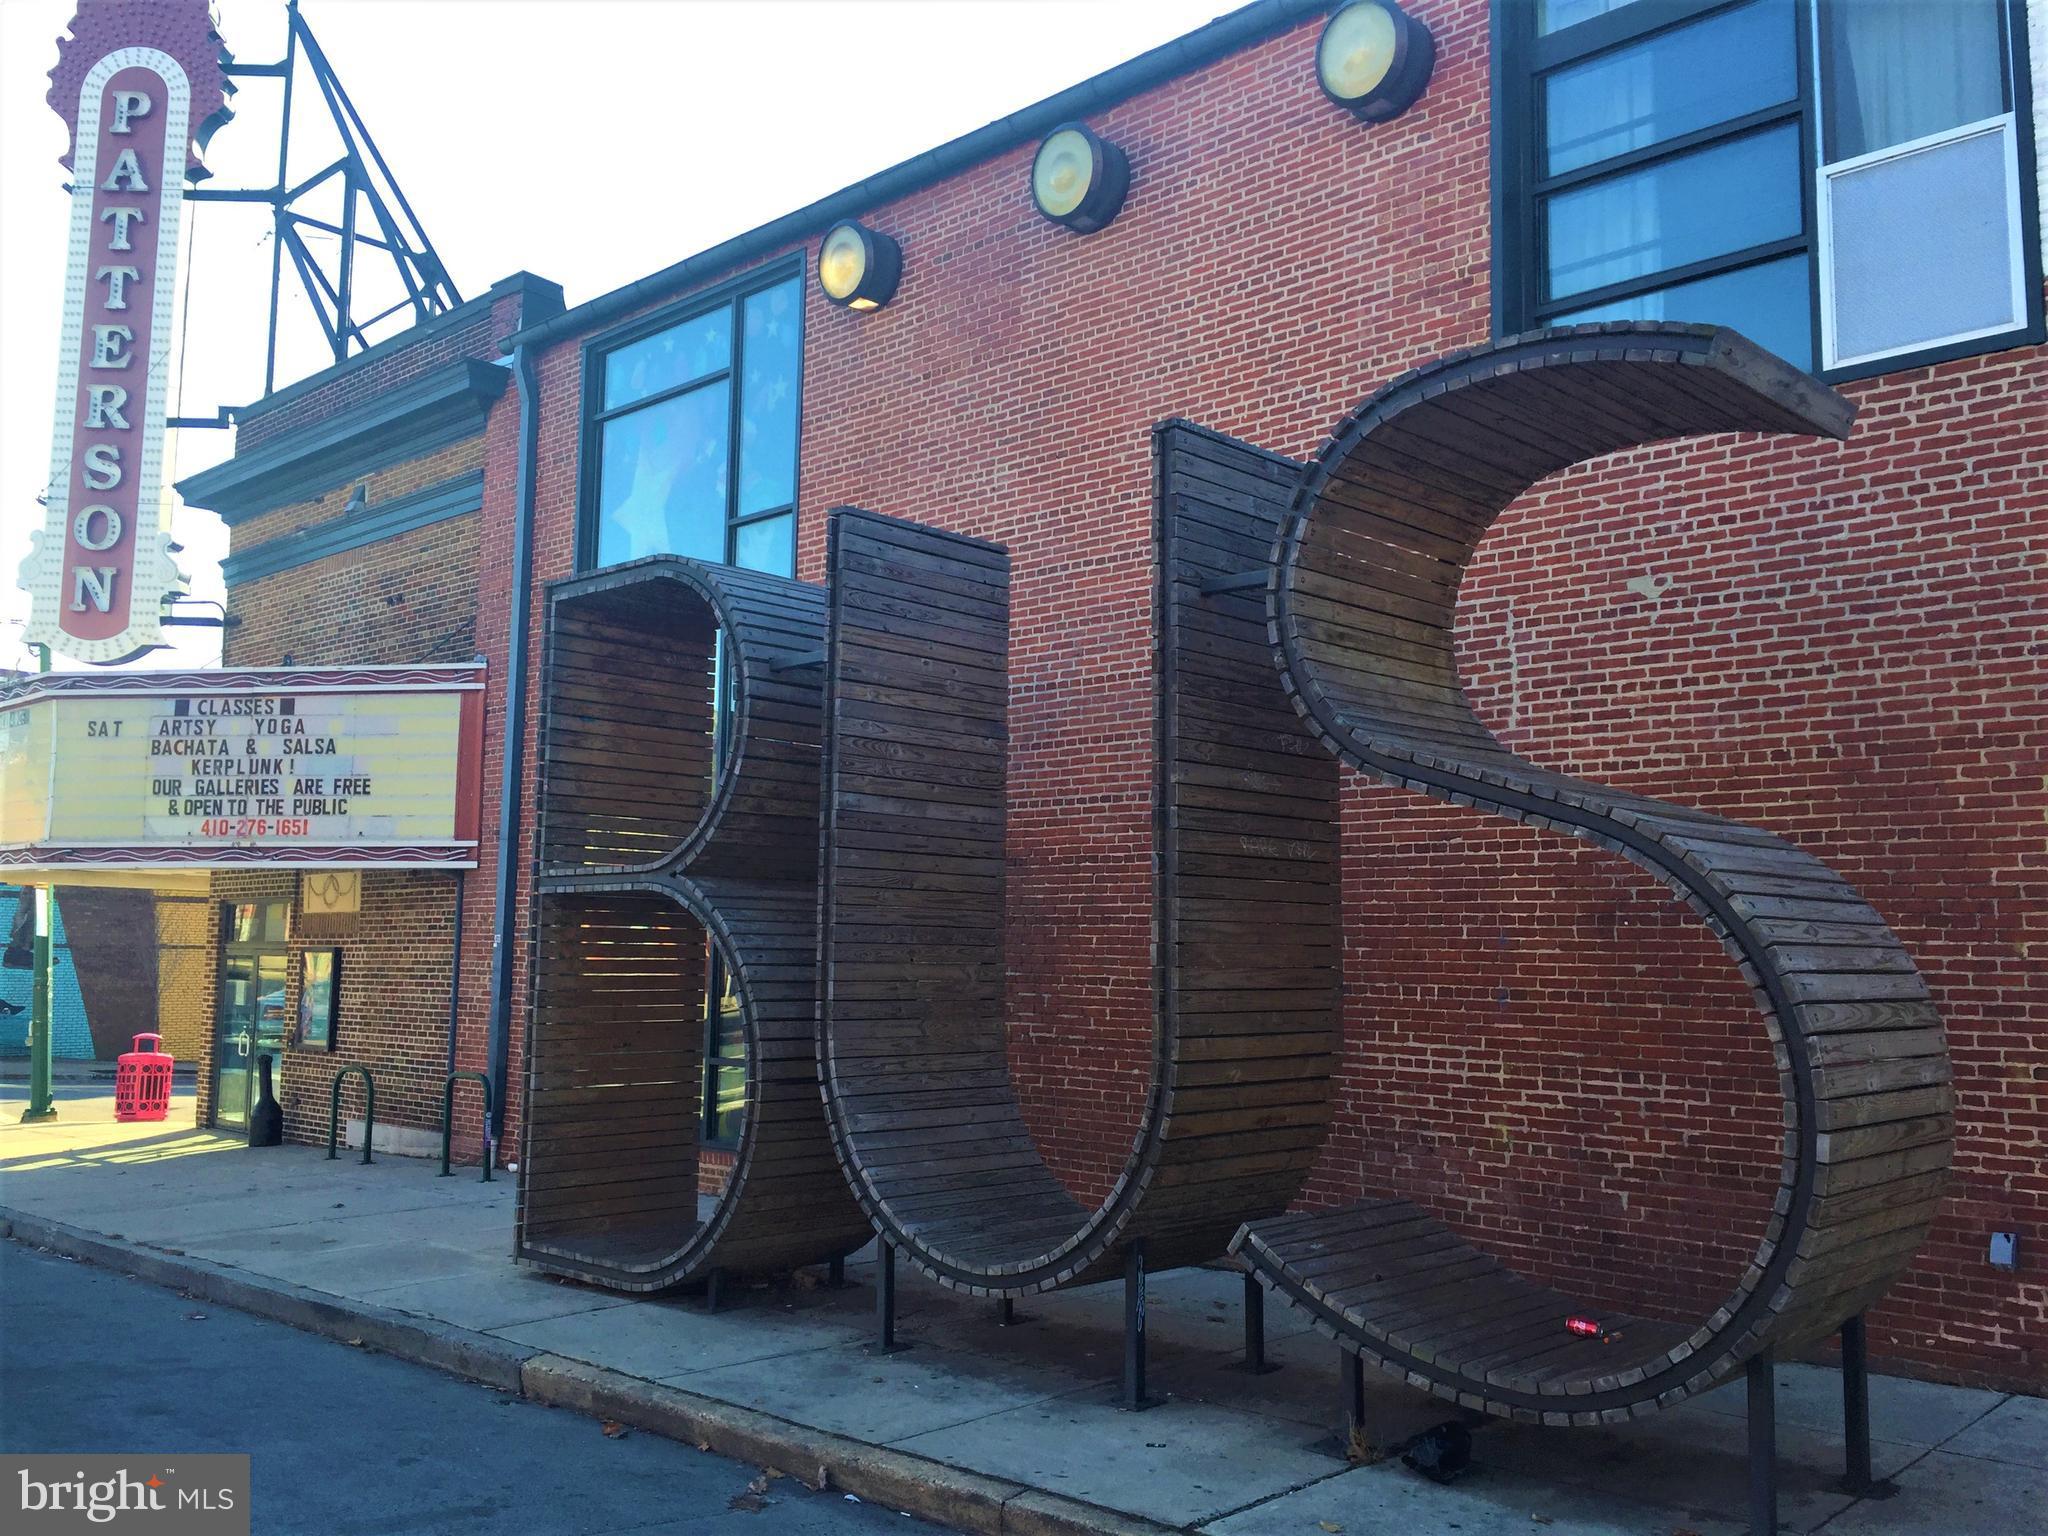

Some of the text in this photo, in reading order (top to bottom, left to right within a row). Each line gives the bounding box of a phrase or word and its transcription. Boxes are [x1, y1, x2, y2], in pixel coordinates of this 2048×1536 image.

[69, 90, 152, 614] PATTERSON
[197, 699, 275, 716] CLASSES
[87, 718, 305, 738] SAT ARTSY YOGA
[151, 737, 337, 756] BACHATA & SALSA
[152, 778, 371, 796] OUR GALLERIES ARE FREE
[168, 798, 348, 816] & OPEN TO THE PUBLIC
[201, 818, 309, 837] 410-276-1651
